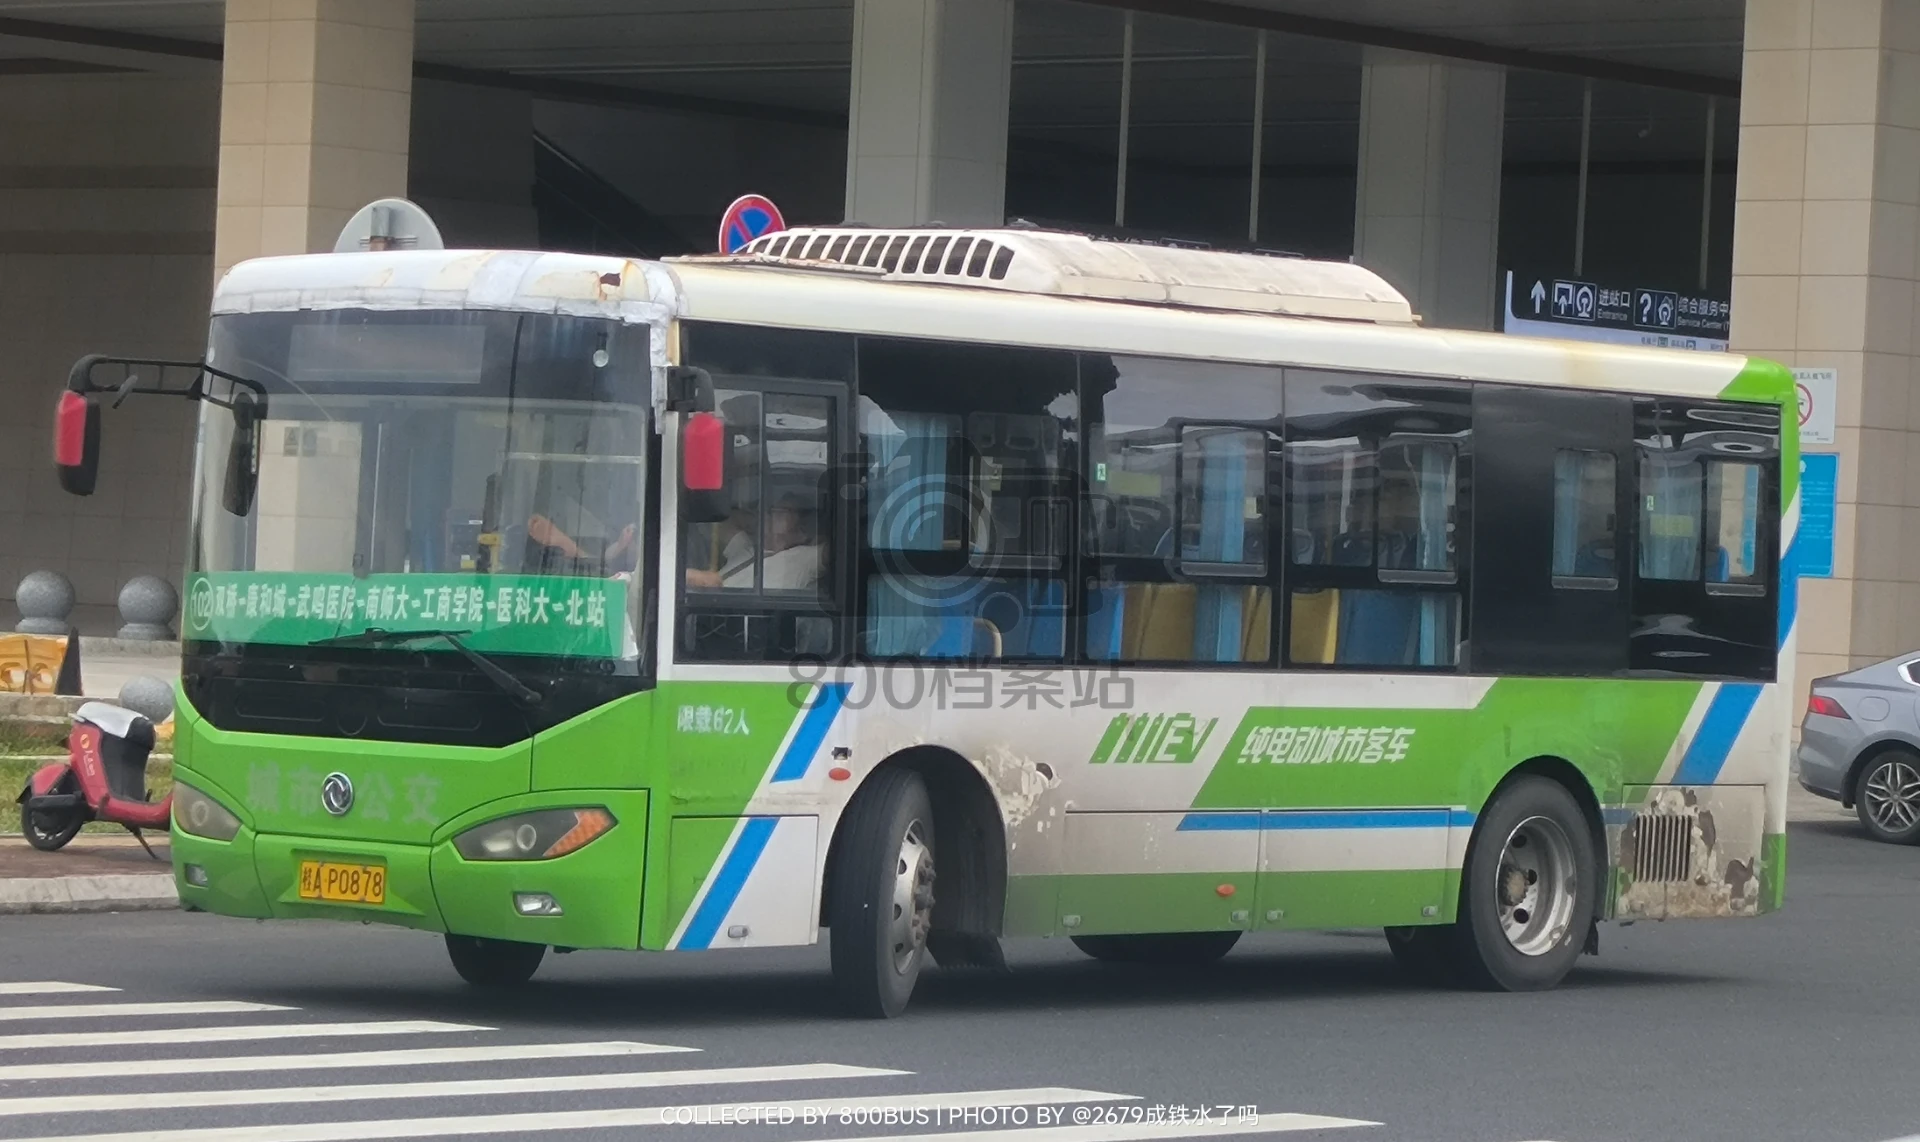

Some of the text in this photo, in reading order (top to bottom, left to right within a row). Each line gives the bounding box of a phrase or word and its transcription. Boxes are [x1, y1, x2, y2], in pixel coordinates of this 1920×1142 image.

[1598, 289, 1630, 307] 进站口
[1678, 296, 1729, 317] 综合服务中
[1597, 309, 1628, 321] Entrance
[1237, 725, 1416, 764] 纯电动城市客车
